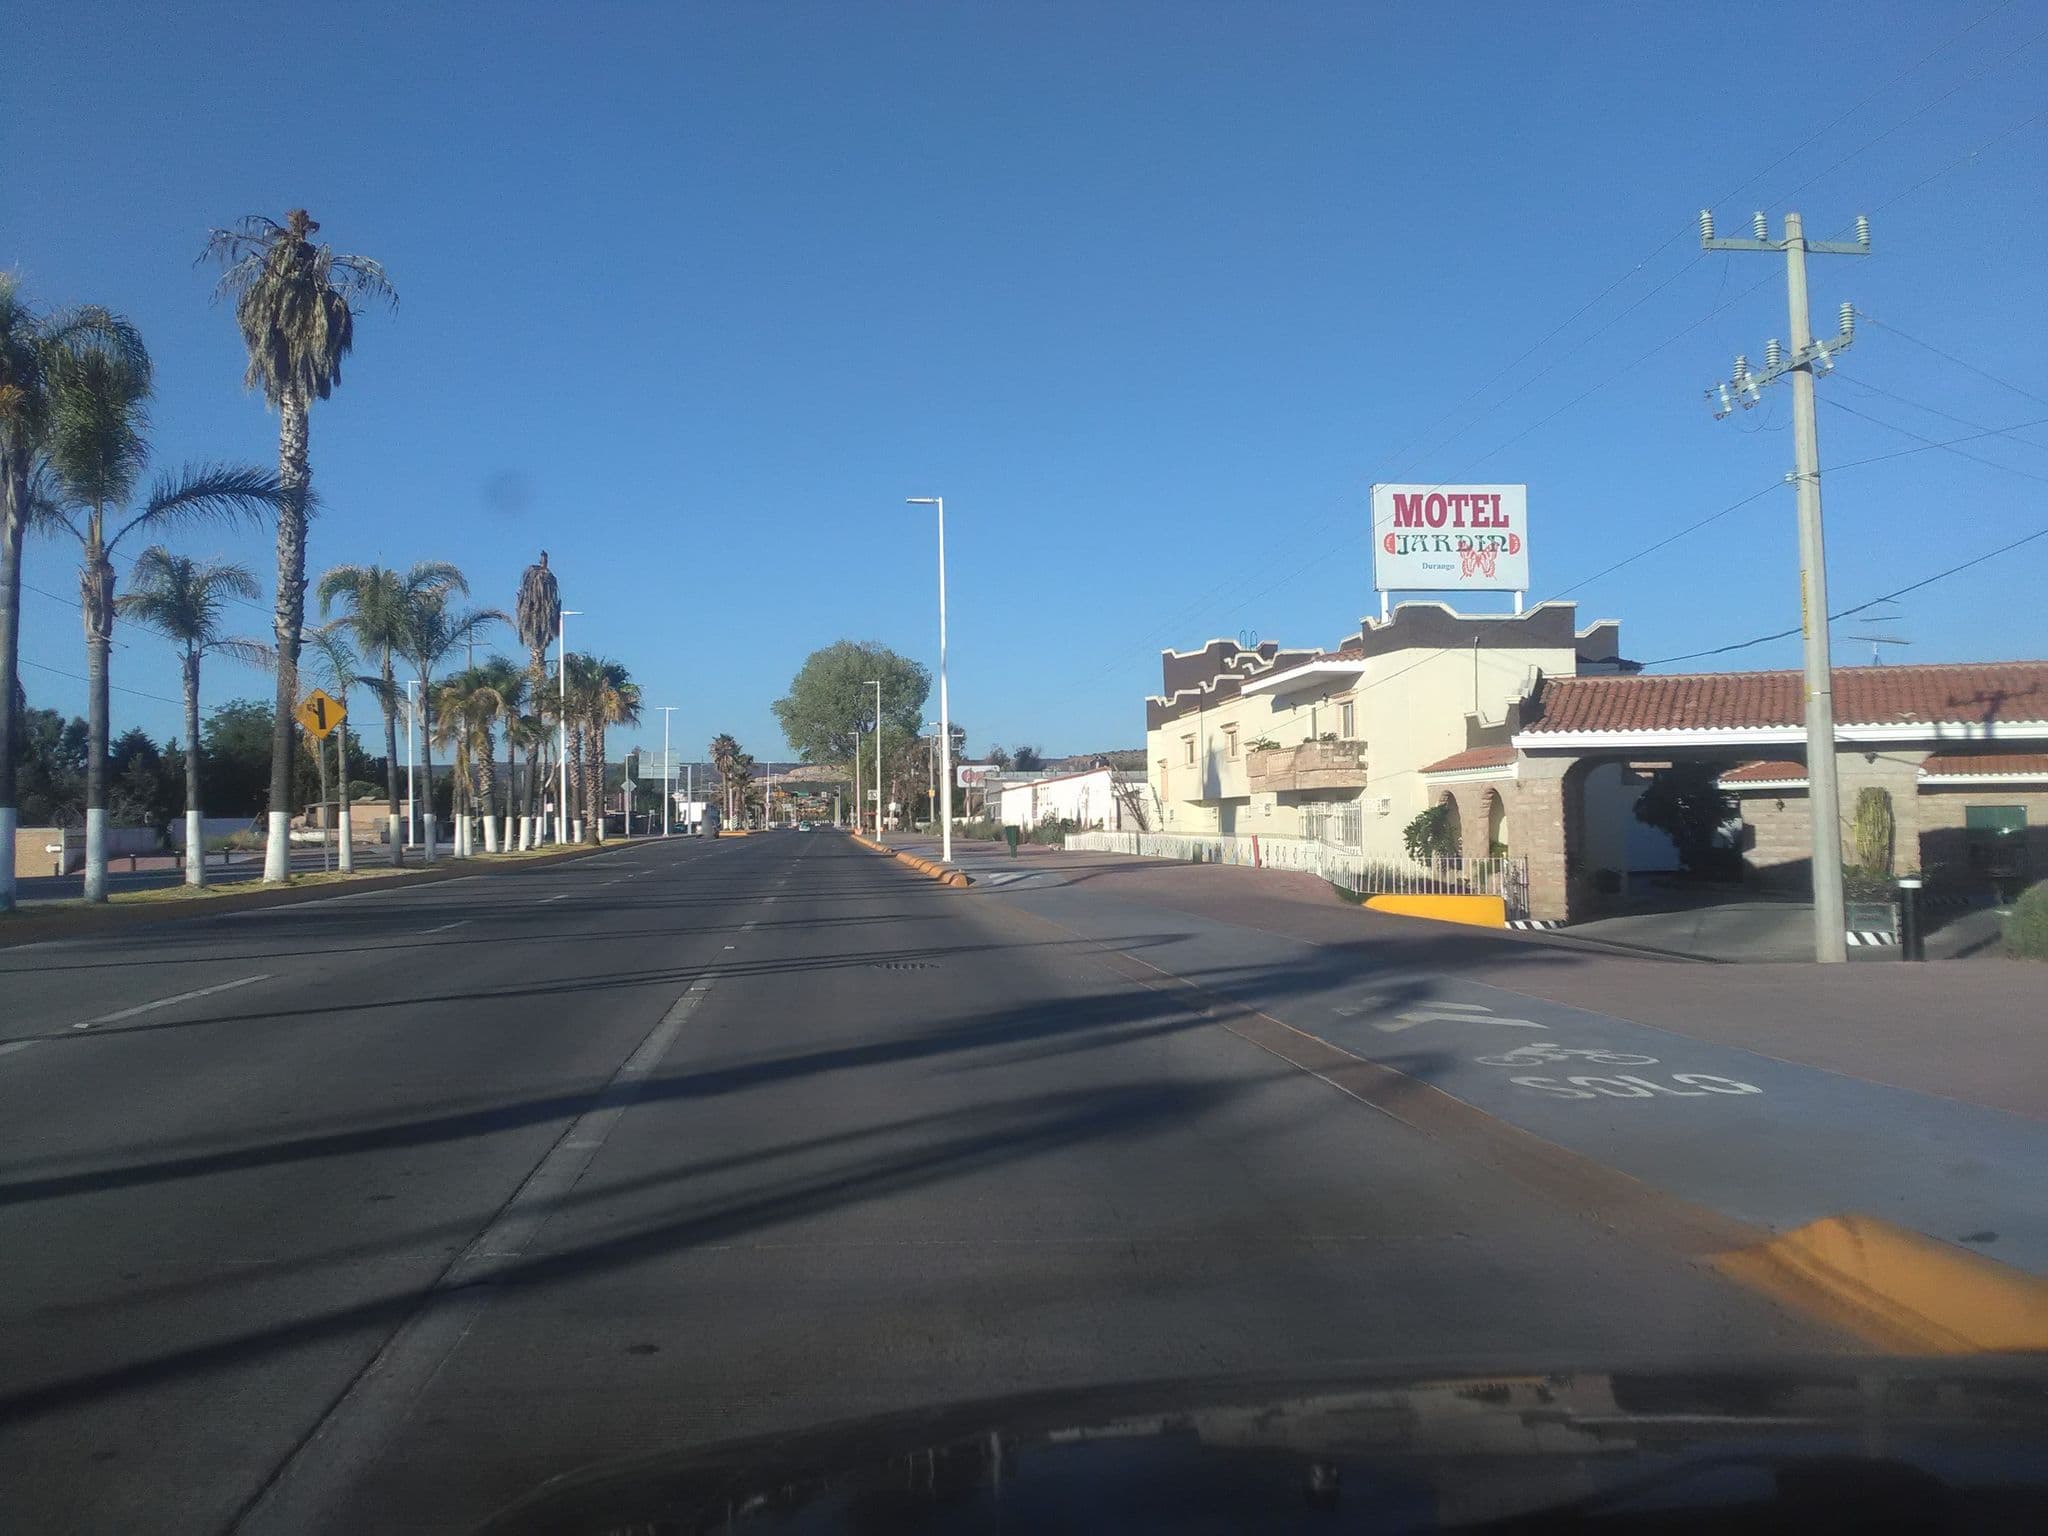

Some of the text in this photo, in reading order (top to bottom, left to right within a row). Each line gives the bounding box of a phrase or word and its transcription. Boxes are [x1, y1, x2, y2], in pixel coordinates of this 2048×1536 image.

[1393, 493, 1509, 528] MOTEL
[1422, 562, 1455, 571] Durango
[1510, 1074, 1763, 1099] SOLO
